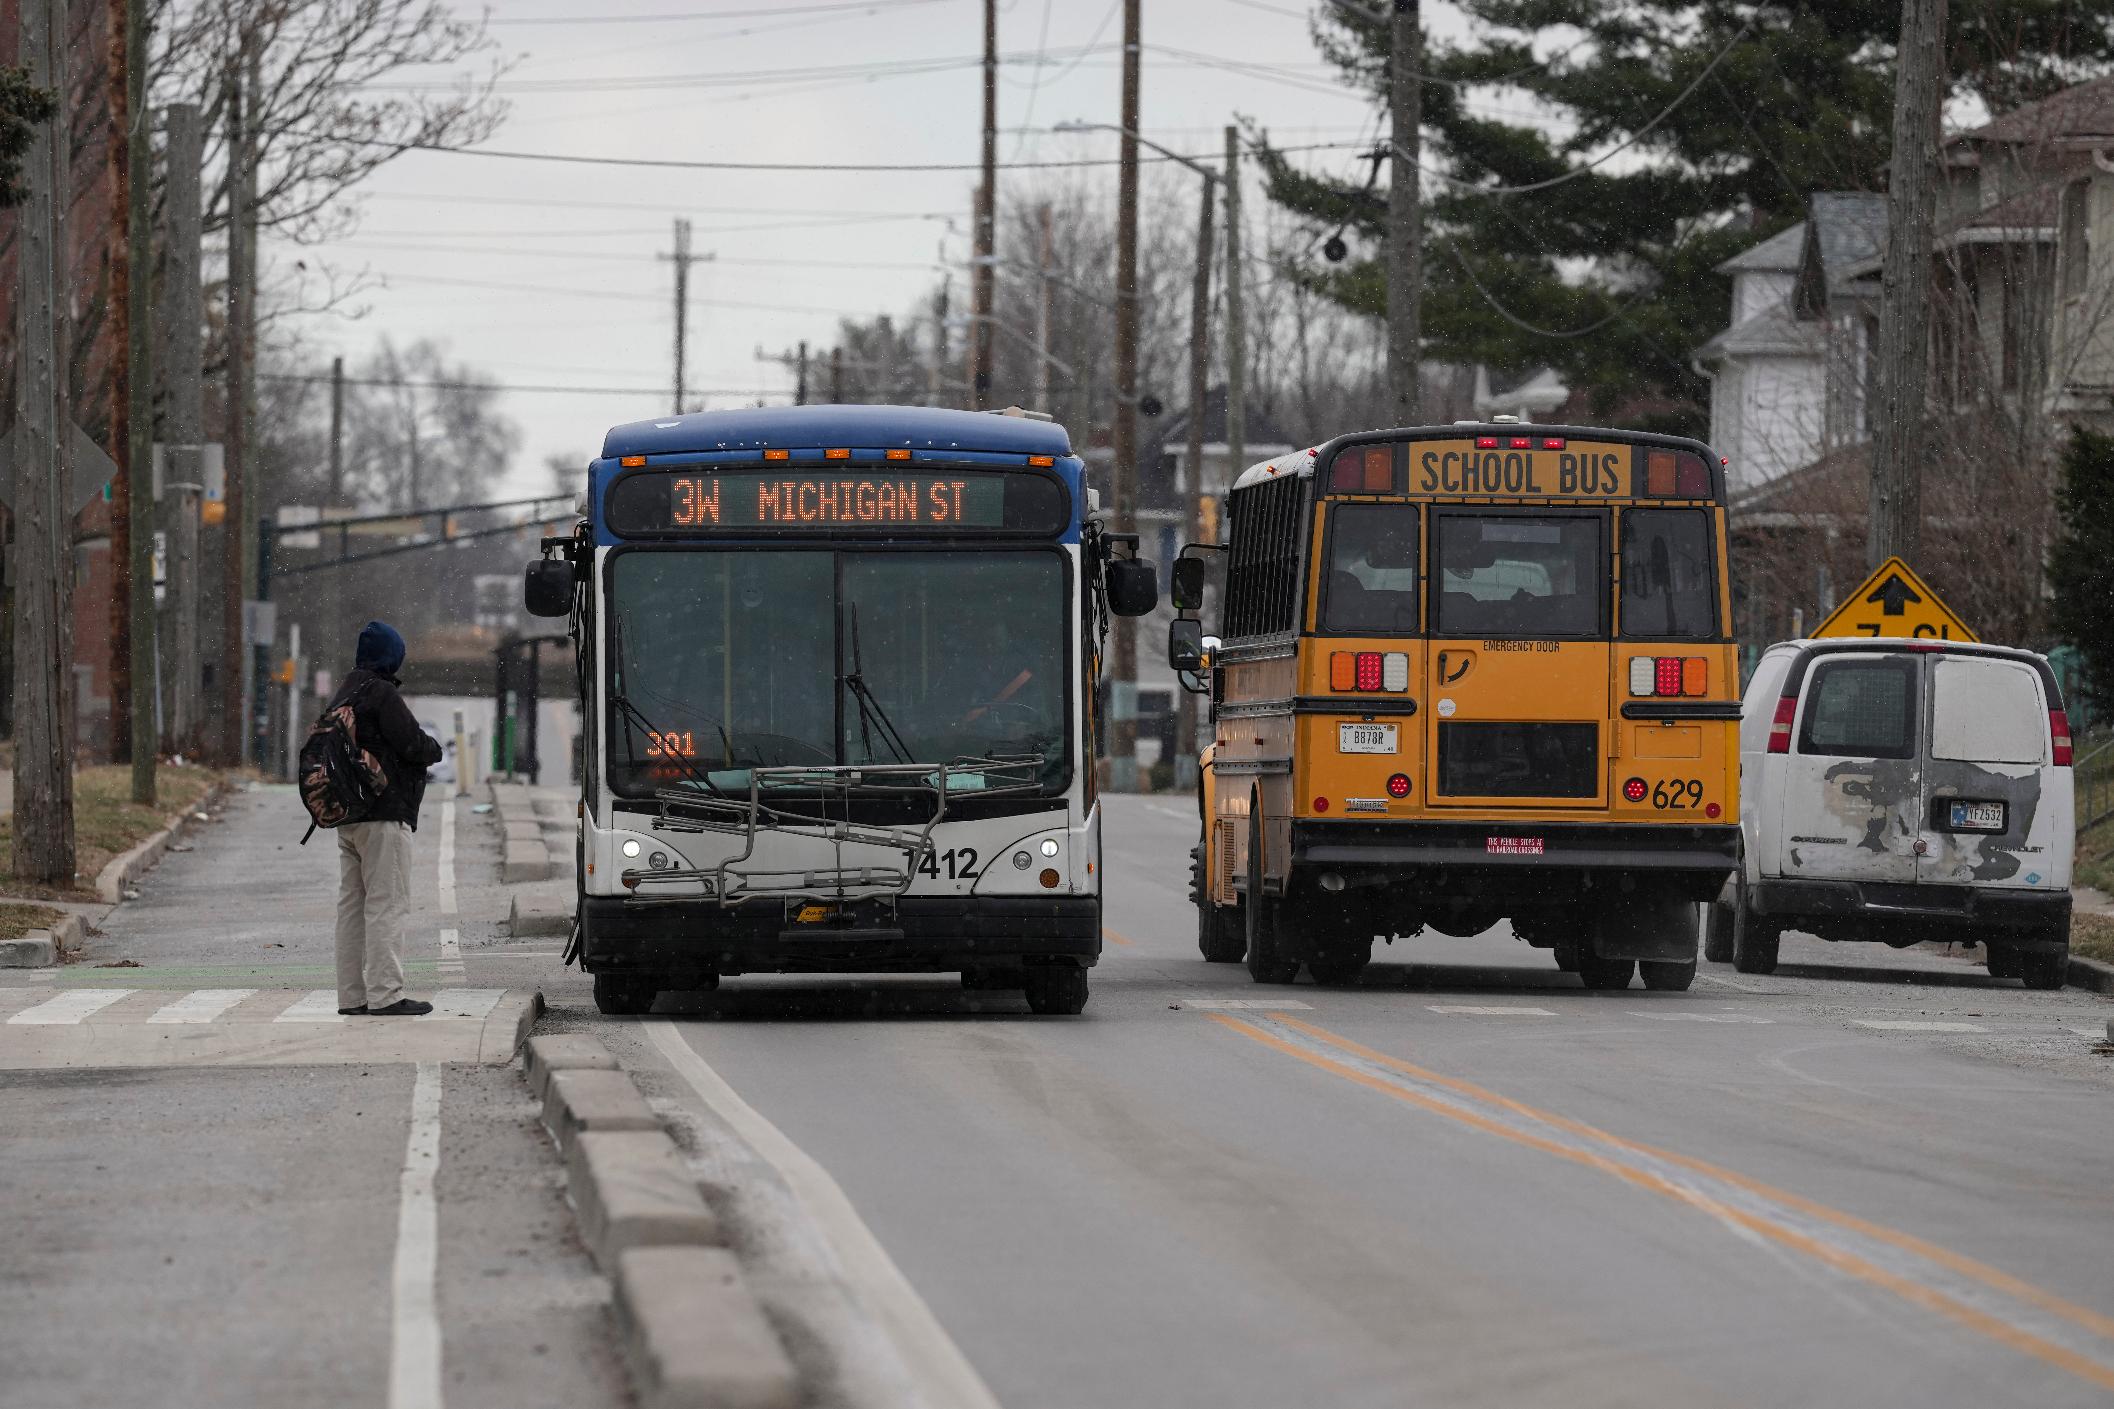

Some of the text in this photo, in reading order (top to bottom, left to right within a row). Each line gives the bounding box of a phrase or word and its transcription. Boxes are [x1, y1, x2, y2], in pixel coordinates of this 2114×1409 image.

[1420, 451, 1619, 494] SCHOOL BUS
[674, 479, 967, 523] 3W MICHIGAN ST
[1483, 640, 1560, 653] EMERGENCY DOOR
[647, 732, 696, 755] 301
[1653, 779, 1703, 809] 629
[1969, 808, 2002, 822] YFZ532
